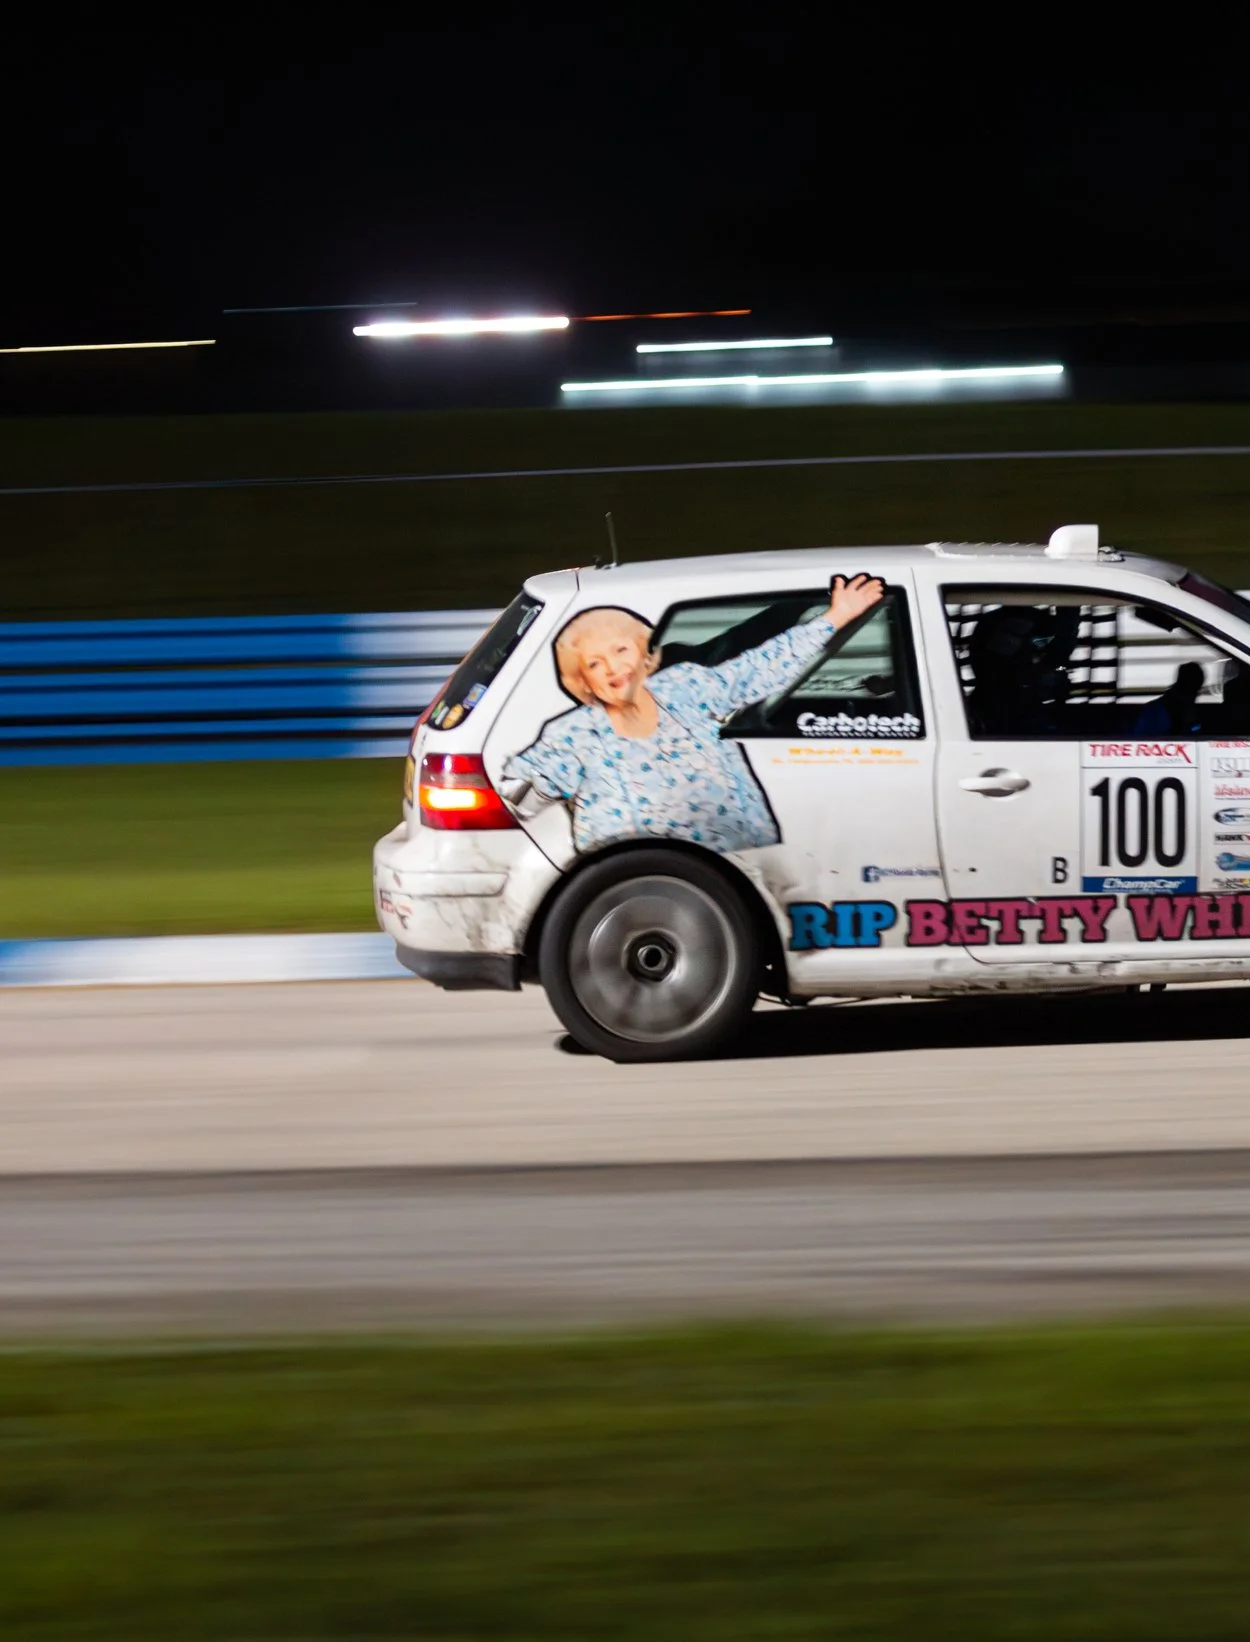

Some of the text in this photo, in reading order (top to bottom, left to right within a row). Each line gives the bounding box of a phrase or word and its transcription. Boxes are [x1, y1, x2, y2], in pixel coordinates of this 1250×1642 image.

[797, 712, 921, 732] Carbotech
[1089, 743, 1132, 756] TIRE
[1136, 743, 1192, 763] RACK
[1090, 776, 1186, 868] 100
[1052, 857, 1069, 884] B
[1102, 878, 1182, 890] ChampCar
[788, 901, 896, 948] RIP
[905, 896, 1117, 945] BETTY
